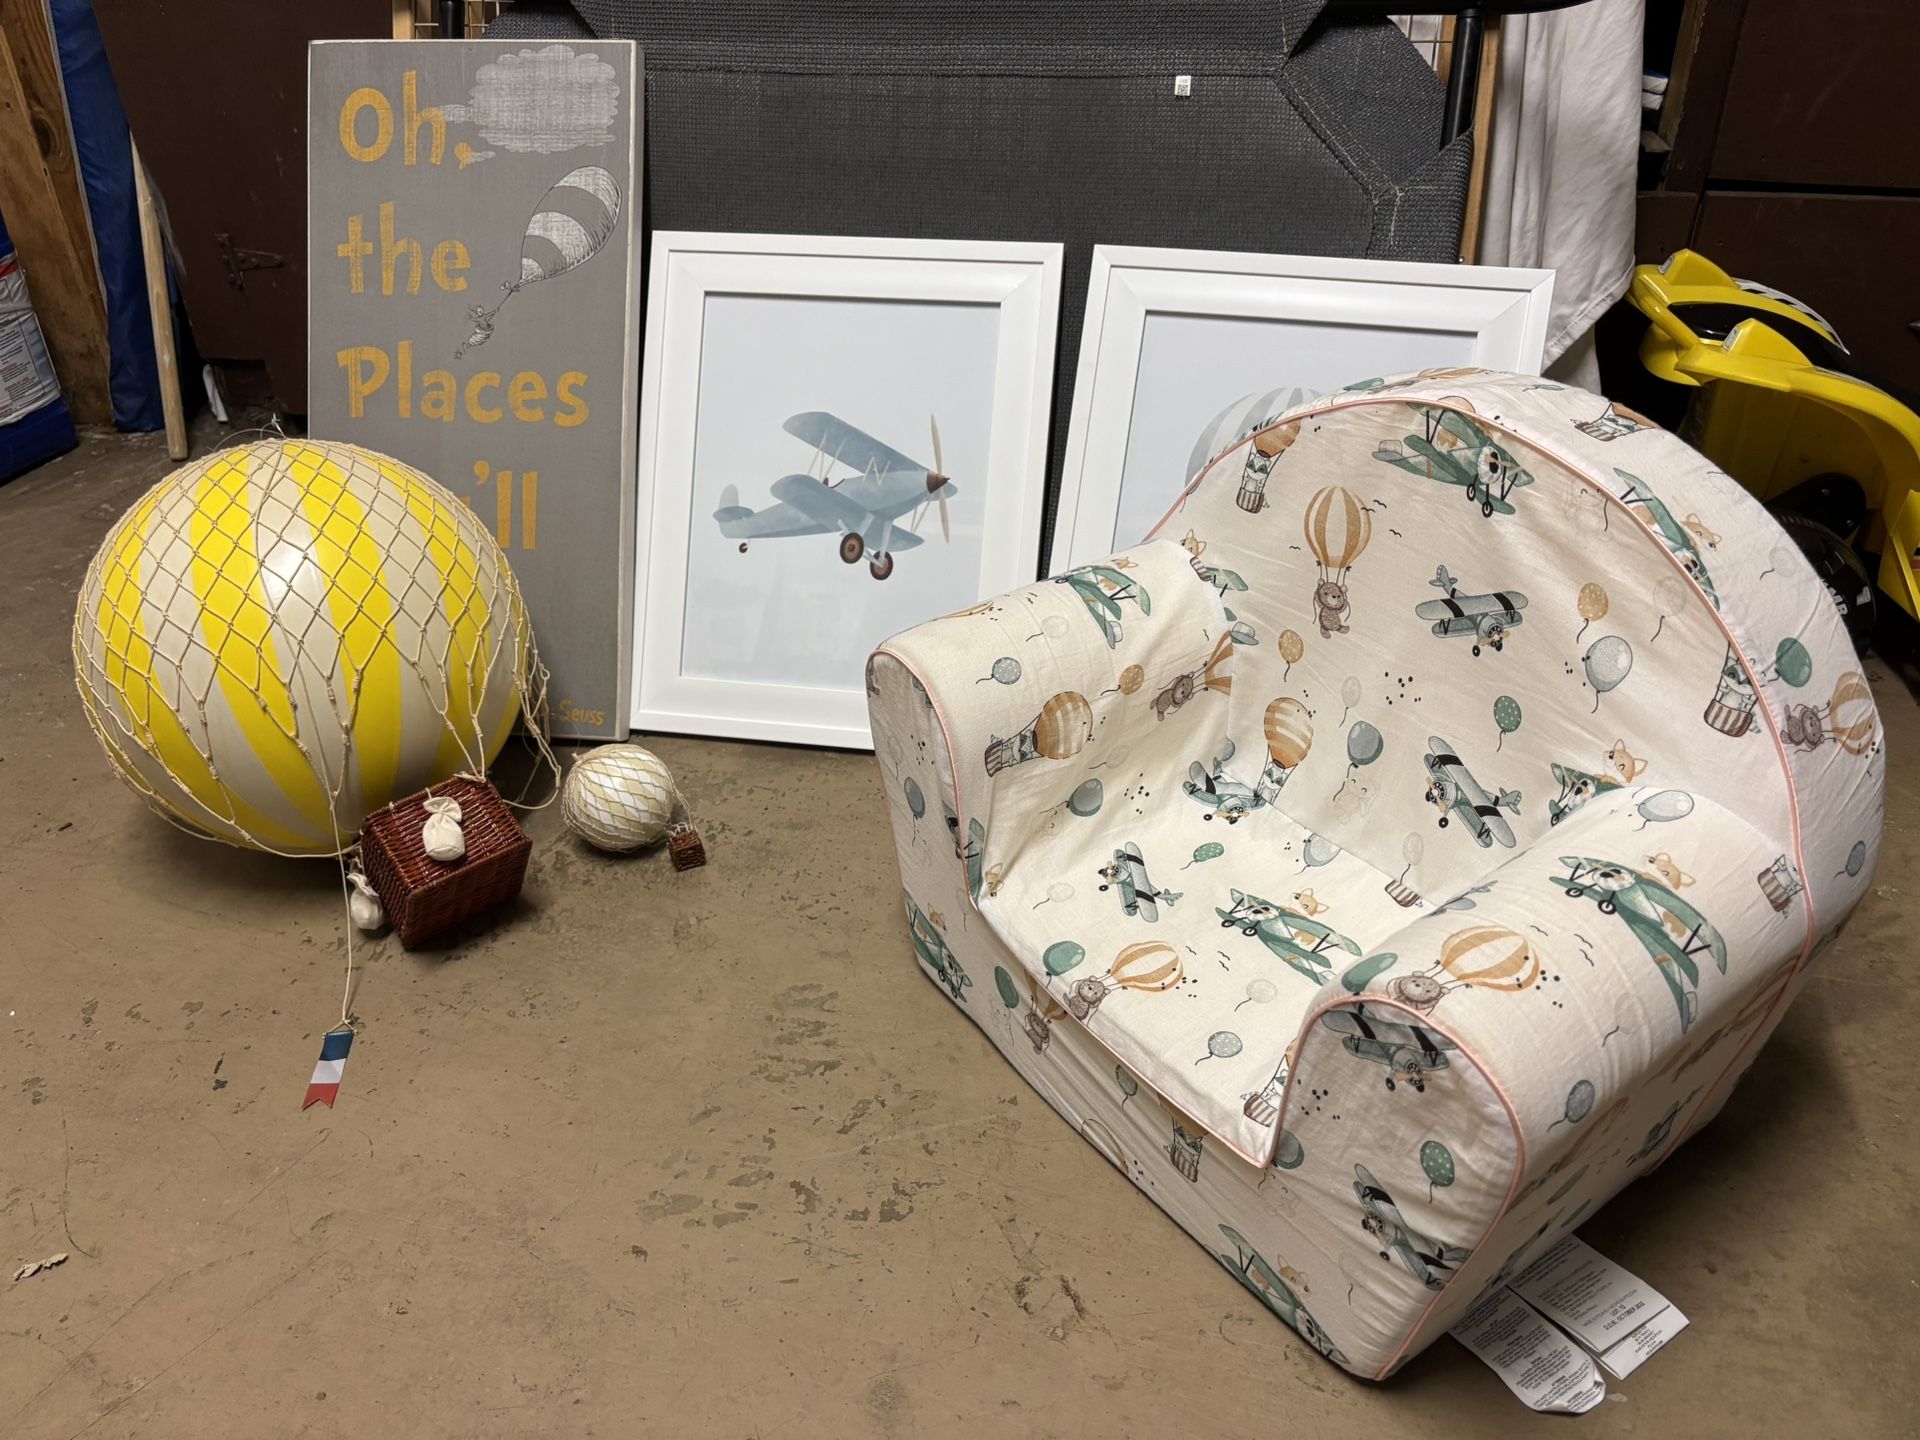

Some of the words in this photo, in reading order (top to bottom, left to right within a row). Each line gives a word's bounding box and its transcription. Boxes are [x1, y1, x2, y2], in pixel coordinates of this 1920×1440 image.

[339, 69, 473, 170] Oh,
[337, 201, 472, 296] the
[337, 340, 590, 428] Places
